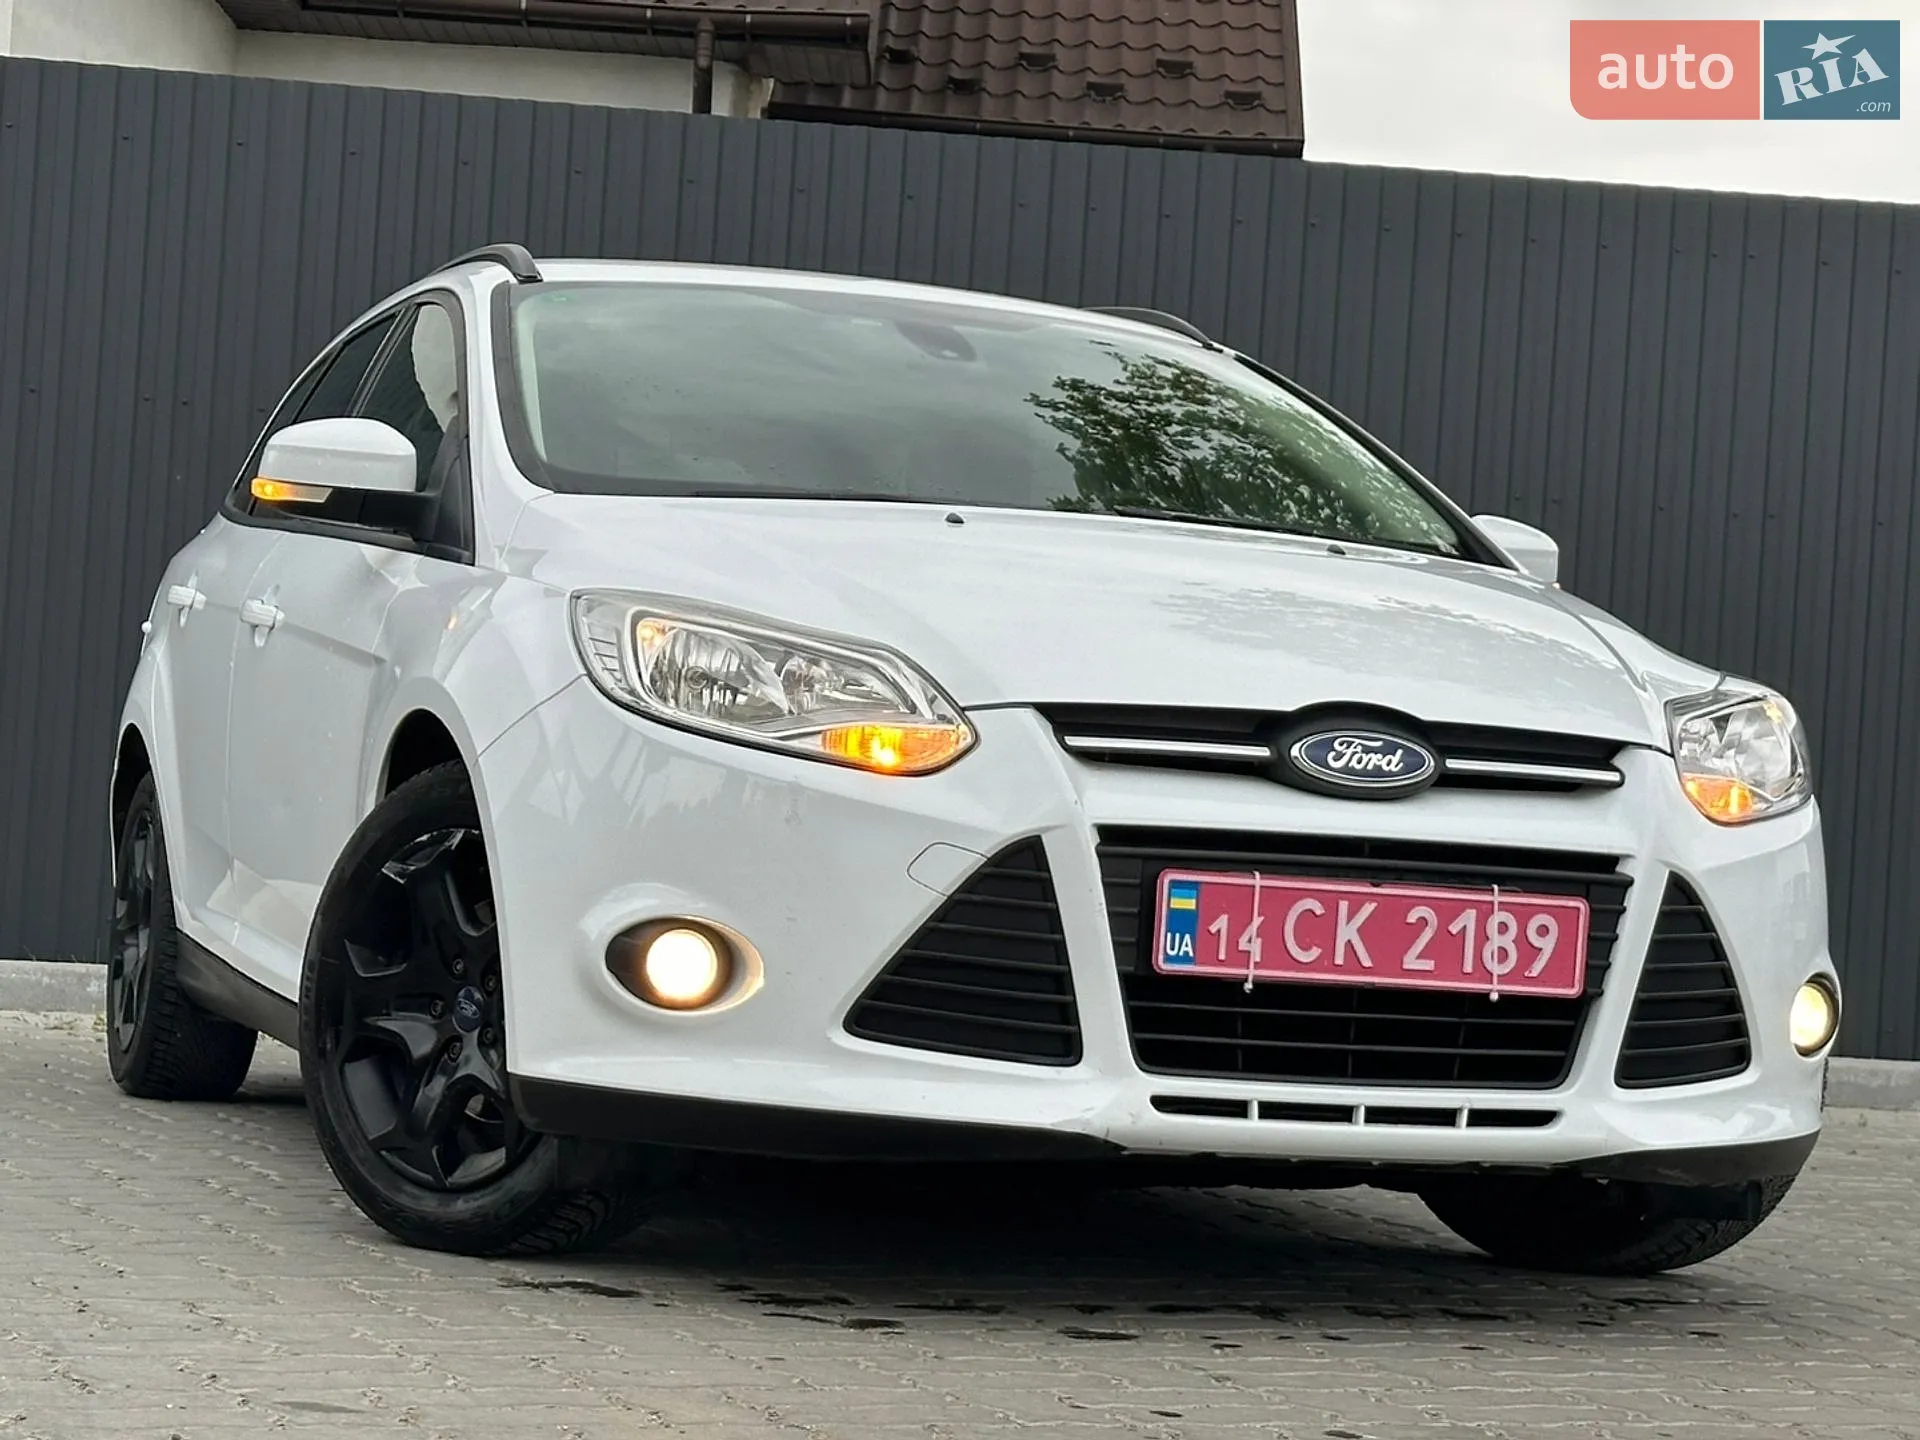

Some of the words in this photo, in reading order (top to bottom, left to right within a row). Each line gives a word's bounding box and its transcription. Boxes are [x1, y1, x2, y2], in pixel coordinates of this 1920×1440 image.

[1327, 737, 1403, 772] Ford
[1166, 933, 1194, 957] UA
[1207, 914, 1264, 963] 14
[1283, 898, 1378, 968] CK
[1402, 906, 1559, 978] 2189
